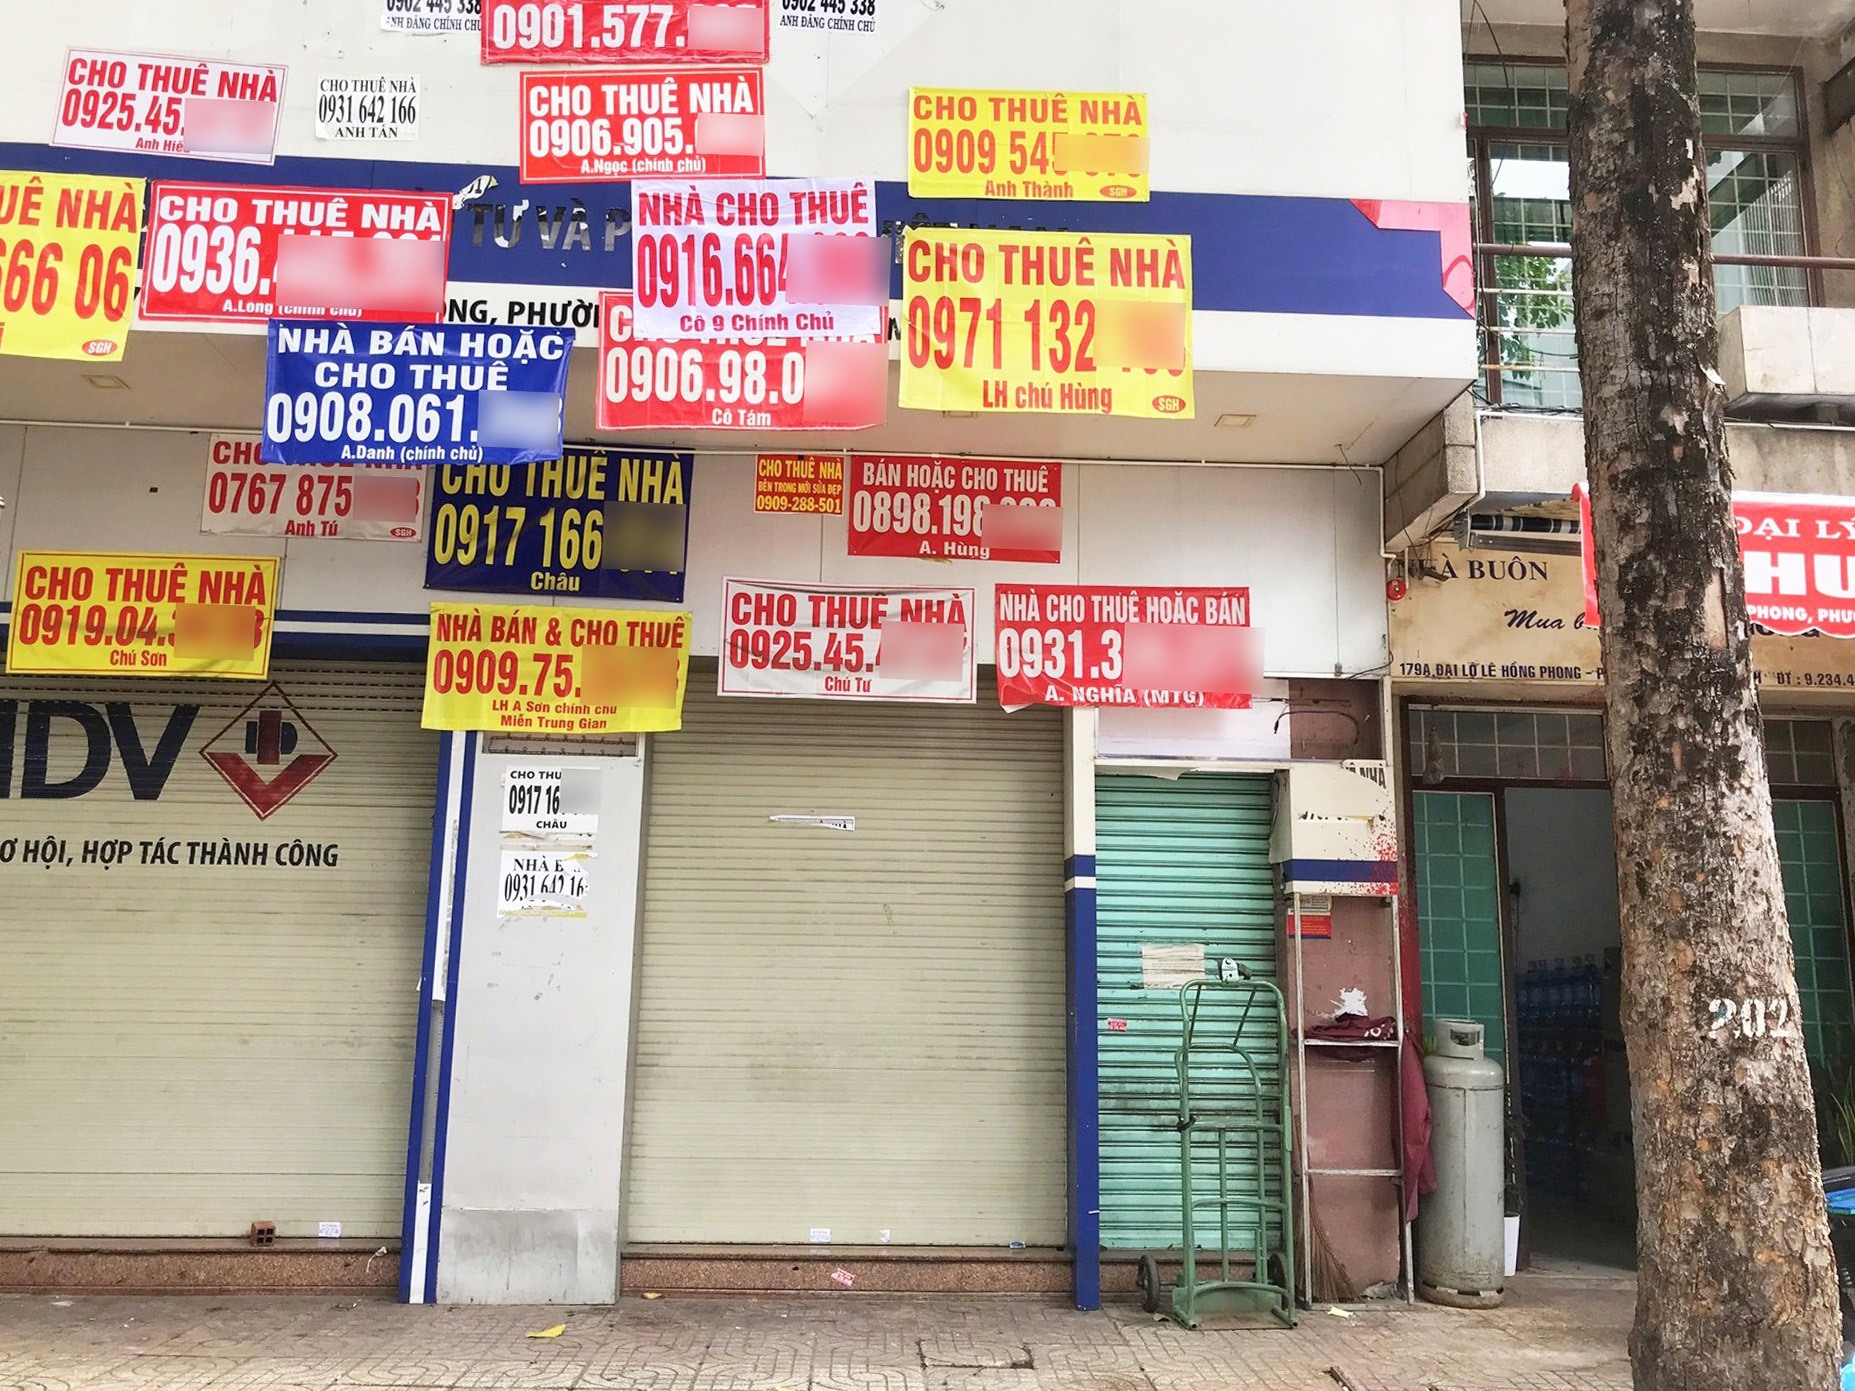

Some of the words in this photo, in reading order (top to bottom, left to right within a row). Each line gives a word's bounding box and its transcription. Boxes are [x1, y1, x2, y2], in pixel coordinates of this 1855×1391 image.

[433, 15, 461, 30] CHÍNH
[780, 14, 799, 27] ANH
[827, 15, 855, 31] CHÍNH
[68, 58, 127, 88] CHO
[138, 62, 210, 96] THUÊ
[217, 69, 277, 102] NHÀ
[320, 78, 349, 93] CHO
[352, 76, 386, 93] THUÊ
[389, 76, 416, 93] NHÀ
[529, 84, 592, 117] CHO
[601, 77, 678, 116] THUÊ
[689, 75, 755, 114] NHÀ
[319, 94, 352, 123] 0931
[359, 95, 385, 123] 642
[391, 95, 416, 124] 166
[913, 95, 977, 122] CHO
[988, 93, 1068, 124] THUÊ
[1080, 95, 1143, 126] NHÀ
[135, 137, 160, 150] Anh
[335, 126, 365, 138] ANH
[913, 128, 997, 174] 0909
[580, 160, 628, 175] A.Ngọc
[984, 180, 1017, 198] Anh
[1022, 181, 1074, 199] Thành
[56, 182, 138, 234] NHÀ
[159, 195, 239, 222] CHO
[251, 197, 349, 228] THUÊ
[360, 201, 442, 232] NHÀ
[638, 185, 705, 226] NHÀ
[715, 192, 779, 226] CHO
[789, 182, 869, 225] THUÊ
[908, 240, 984, 283] CHO
[998, 237, 1095, 287] THUÊ
[1110, 239, 1186, 289] NHÀ
[0, 238, 64, 316] 66
[74, 243, 132, 323] 06
[223, 302, 274, 316] A.Long
[680, 315, 706, 332] Cô
[712, 315, 724, 331] 9
[731, 314, 789, 331] Chính
[795, 311, 834, 330] Chủ
[278, 323, 356, 355] NHÀ
[369, 325, 445, 356] BÁN
[460, 329, 564, 365] HOẶC
[908, 296, 1002, 370] 0971
[1024, 299, 1097, 374] 132
[315, 362, 396, 390] CHO
[409, 361, 509, 391] THUÊ
[982, 380, 1008, 408] LH
[1015, 383, 1053, 409] chú
[1060, 383, 1112, 413] Hùng
[712, 408, 733, 425] Cô
[738, 410, 771, 426] Tám
[341, 444, 395, 460] A.Danh
[400, 445, 446, 462] (chính
[450, 446, 483, 462] chủ)
[618, 452, 685, 504] NHÀ
[758, 458, 782, 478] CHO
[785, 456, 815, 479] THUÊ
[819, 457, 842, 480] NHÀ
[863, 461, 901, 487] BÁN
[907, 460, 955, 493] HOẶC
[962, 467, 998, 490] CHO
[1004, 465, 1049, 493] THUÊ
[208, 472, 287, 514] 0767
[296, 474, 353, 517] 875
[756, 494, 841, 513] 0909-288-501
[285, 520, 315, 536] Anh
[321, 520, 338, 537] Tú
[434, 503, 527, 566] 0917
[539, 507, 604, 570] 166
[944, 541, 990, 559] Hùng
[1467, 556, 1548, 581] BUÔN
[24, 565, 94, 600] CHO
[105, 562, 188, 603] THUÊ
[198, 564, 266, 605] NHÀ
[530, 571, 580, 592] Châu
[731, 592, 797, 626] CHO
[808, 592, 888, 629] THUÊ
[901, 593, 967, 631] NHÀ
[1000, 589, 1040, 622] NHÀ
[1046, 594, 1085, 623] CHO
[1090, 590, 1140, 623] THUÊ
[1205, 592, 1246, 625] BÁN
[1504, 608, 1566, 629] Mua
[436, 608, 481, 642] NHÀ
[490, 609, 537, 645] BÁN
[545, 618, 561, 646] &
[570, 619, 618, 647] CHO
[626, 616, 685, 649] THUÊ
[110, 650, 136, 666] Chú
[141, 650, 167, 666] Sơn
[1481, 662, 1497, 677] LÊ
[1539, 667, 1582, 679] PHONG
[825, 676, 850, 692] Chú
[855, 677, 872, 692] Tư
[1072, 684, 1137, 703] NGHĨA
[492, 700, 508, 711] LH
[512, 700, 521, 711] A
[526, 701, 550, 712] Sơn
[537, 716, 574, 731] Trung
[579, 718, 607, 729] Gian
[510, 771, 535, 780] CHO
[508, 784, 542, 814] 0917
[536, 819, 567, 829] CHÂU
[22, 835, 74, 870] HỘI,
[81, 838, 133, 870] HỢP
[140, 836, 182, 865] TÁC
[187, 837, 269, 867] THÀNH
[275, 838, 339, 867] CÔNG
[513, 855, 549, 872] NHÀ
